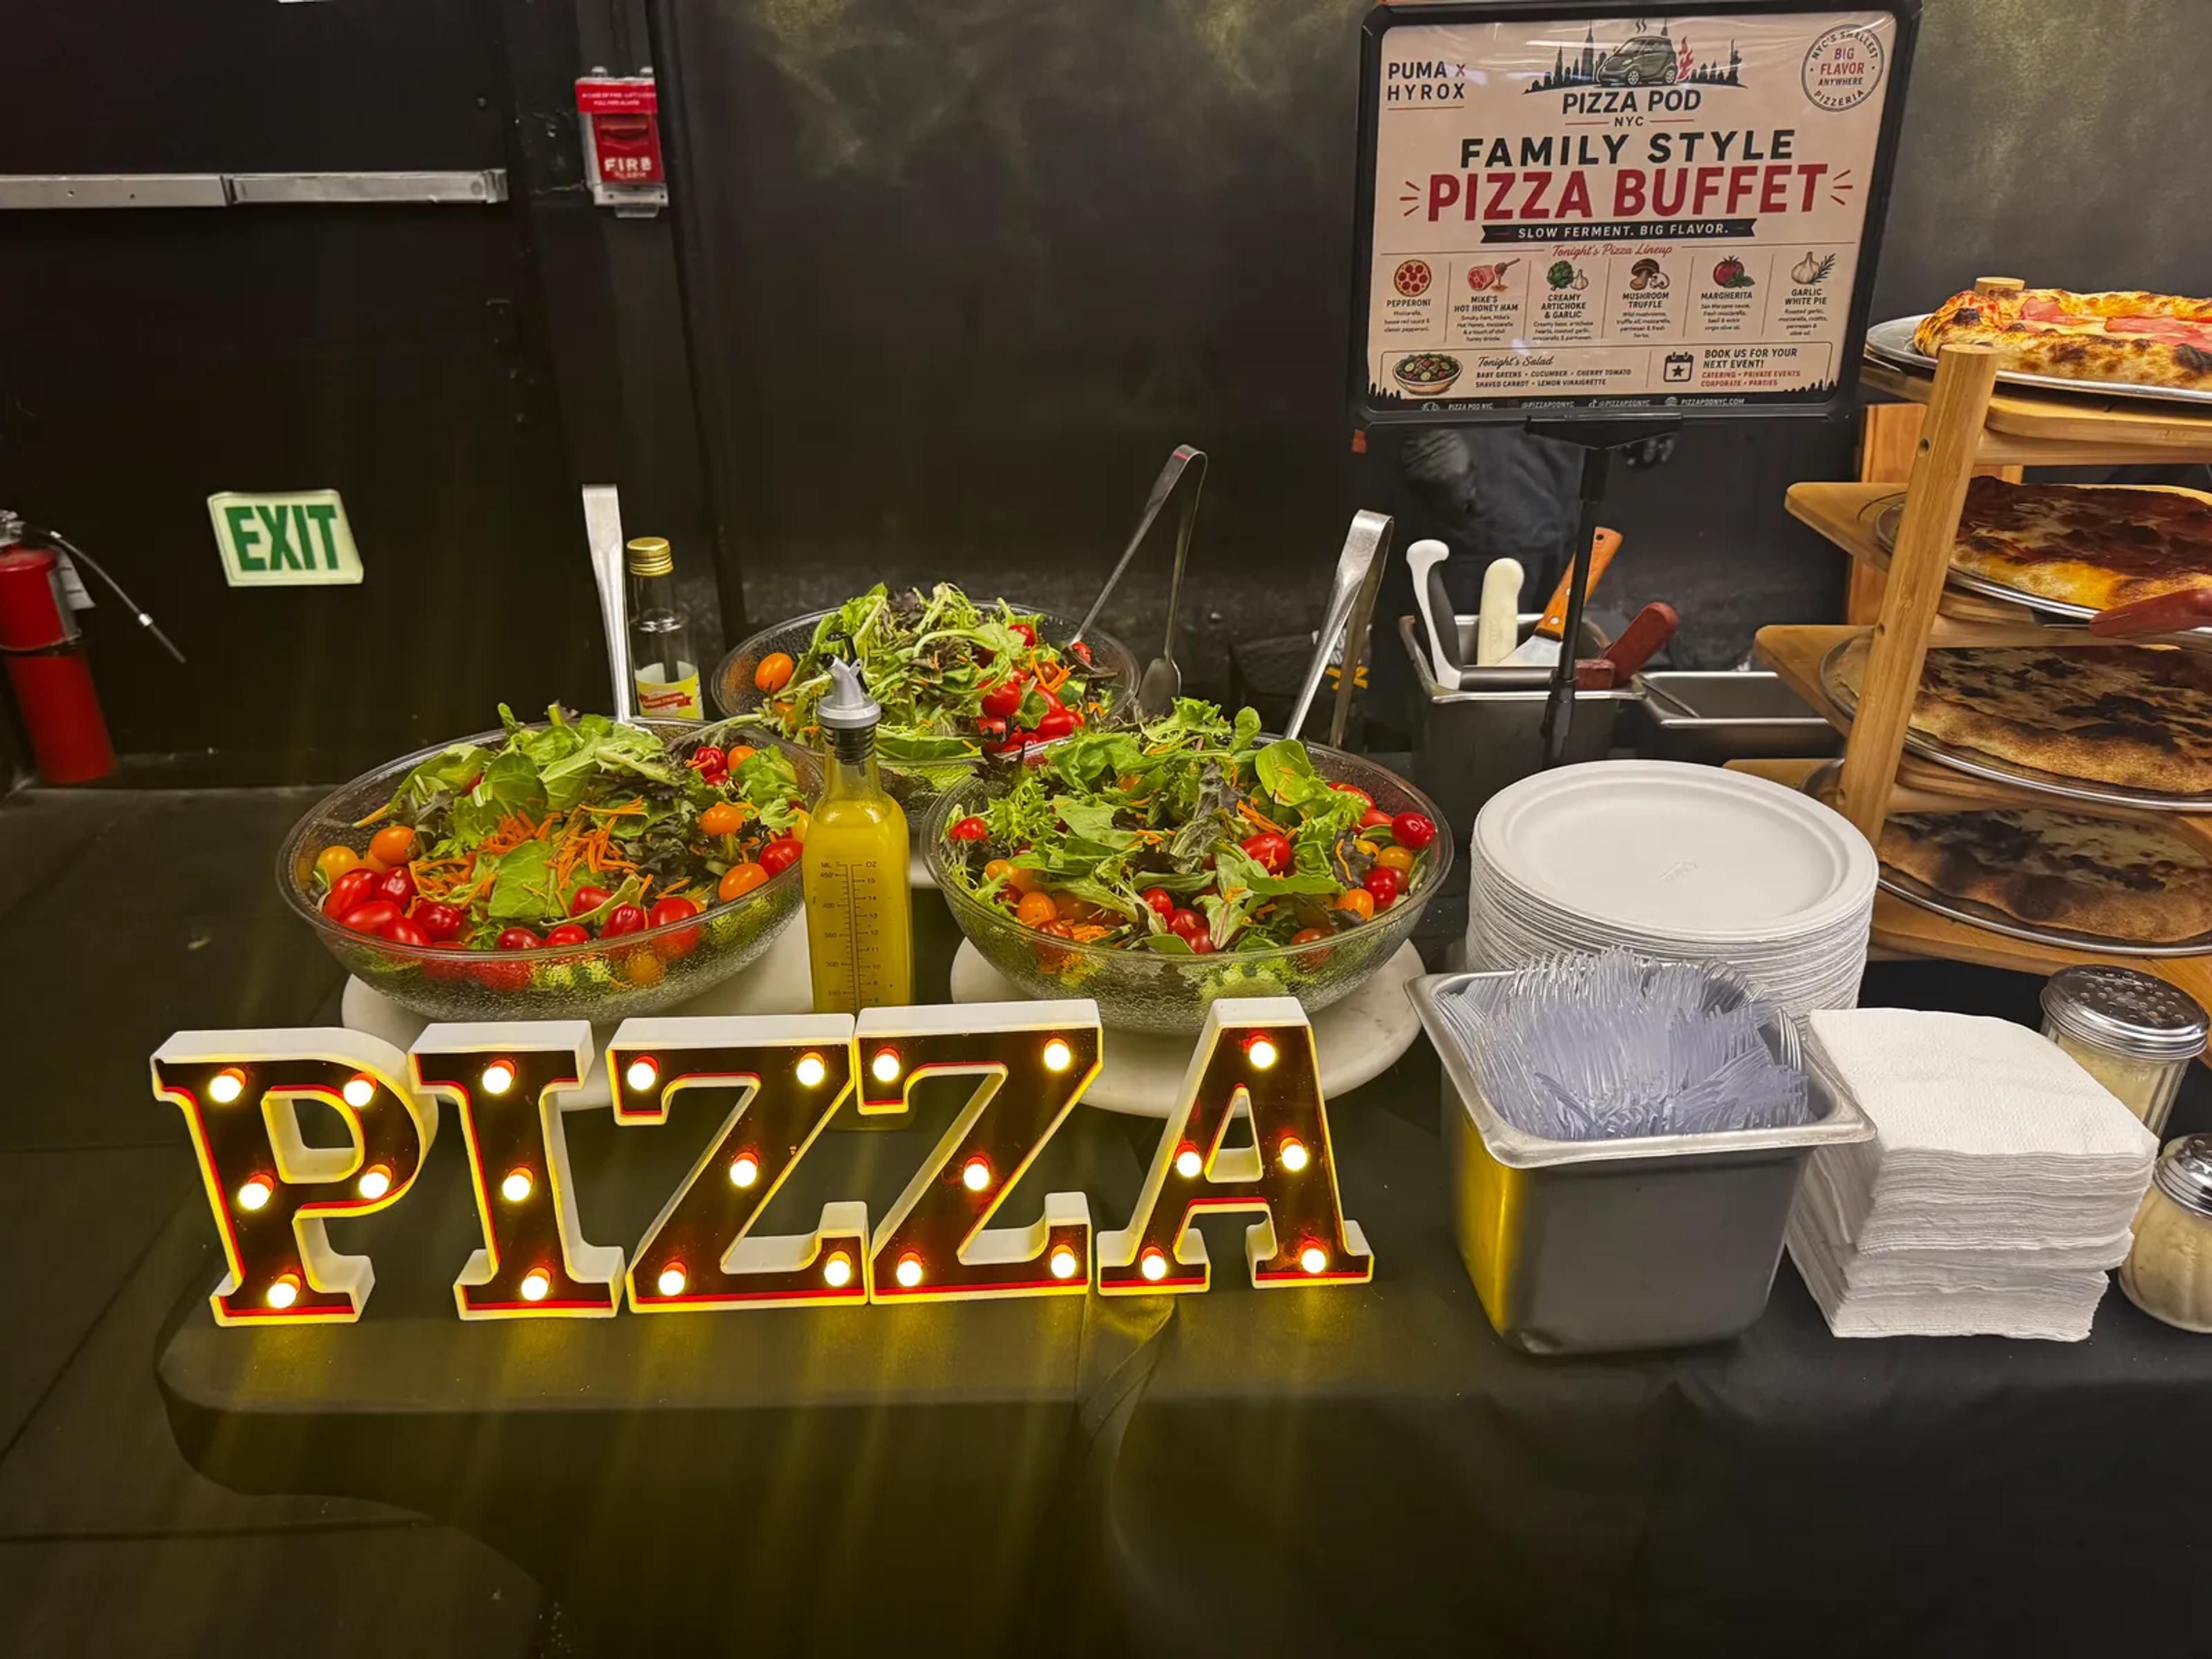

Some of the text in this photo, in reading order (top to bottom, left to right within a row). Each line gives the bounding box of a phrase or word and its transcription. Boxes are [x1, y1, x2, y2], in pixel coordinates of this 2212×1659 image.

[1812, 31, 1878, 59] NYC'S SMALLEST
[1835, 48, 1855, 60] BIG
[1388, 61, 1447, 79] PUMA
[1820, 62, 1865, 75] FLAVOR
[1818, 77, 1863, 86] ANYWHERE
[1387, 84, 1465, 101] HYROX
[1814, 90, 1864, 106] PIZZERIA
[1562, 89, 1701, 115] PIZZA POD
[1614, 116, 1643, 127] NYC
[1461, 130, 1795, 168] FAMILY STYLE
[604, 157, 652, 172] FIRE
[1428, 164, 1828, 222] PIZZA BUFFET
[1517, 224, 1729, 238] SLOW FERMENT. BIG FLAVOR.
[1552, 243, 1673, 260] Tonight's Pizza Lineup
[1700, 291, 1752, 300] MARGHERITA
[1791, 288, 1822, 296] GARLIC
[1387, 299, 1431, 307] PEPPERONI
[1541, 302, 1586, 310] ARTICHOKE
[1628, 300, 1662, 308] TRUFFLE
[1705, 348, 1797, 358] BOOK US FOR YOUR
[1478, 355, 1554, 369] Tonight's Salad
[1703, 359, 1764, 369] NEXT EVENT!
[225, 505, 337, 571] EXIT
[151, 997, 1376, 1326] PIZZA
